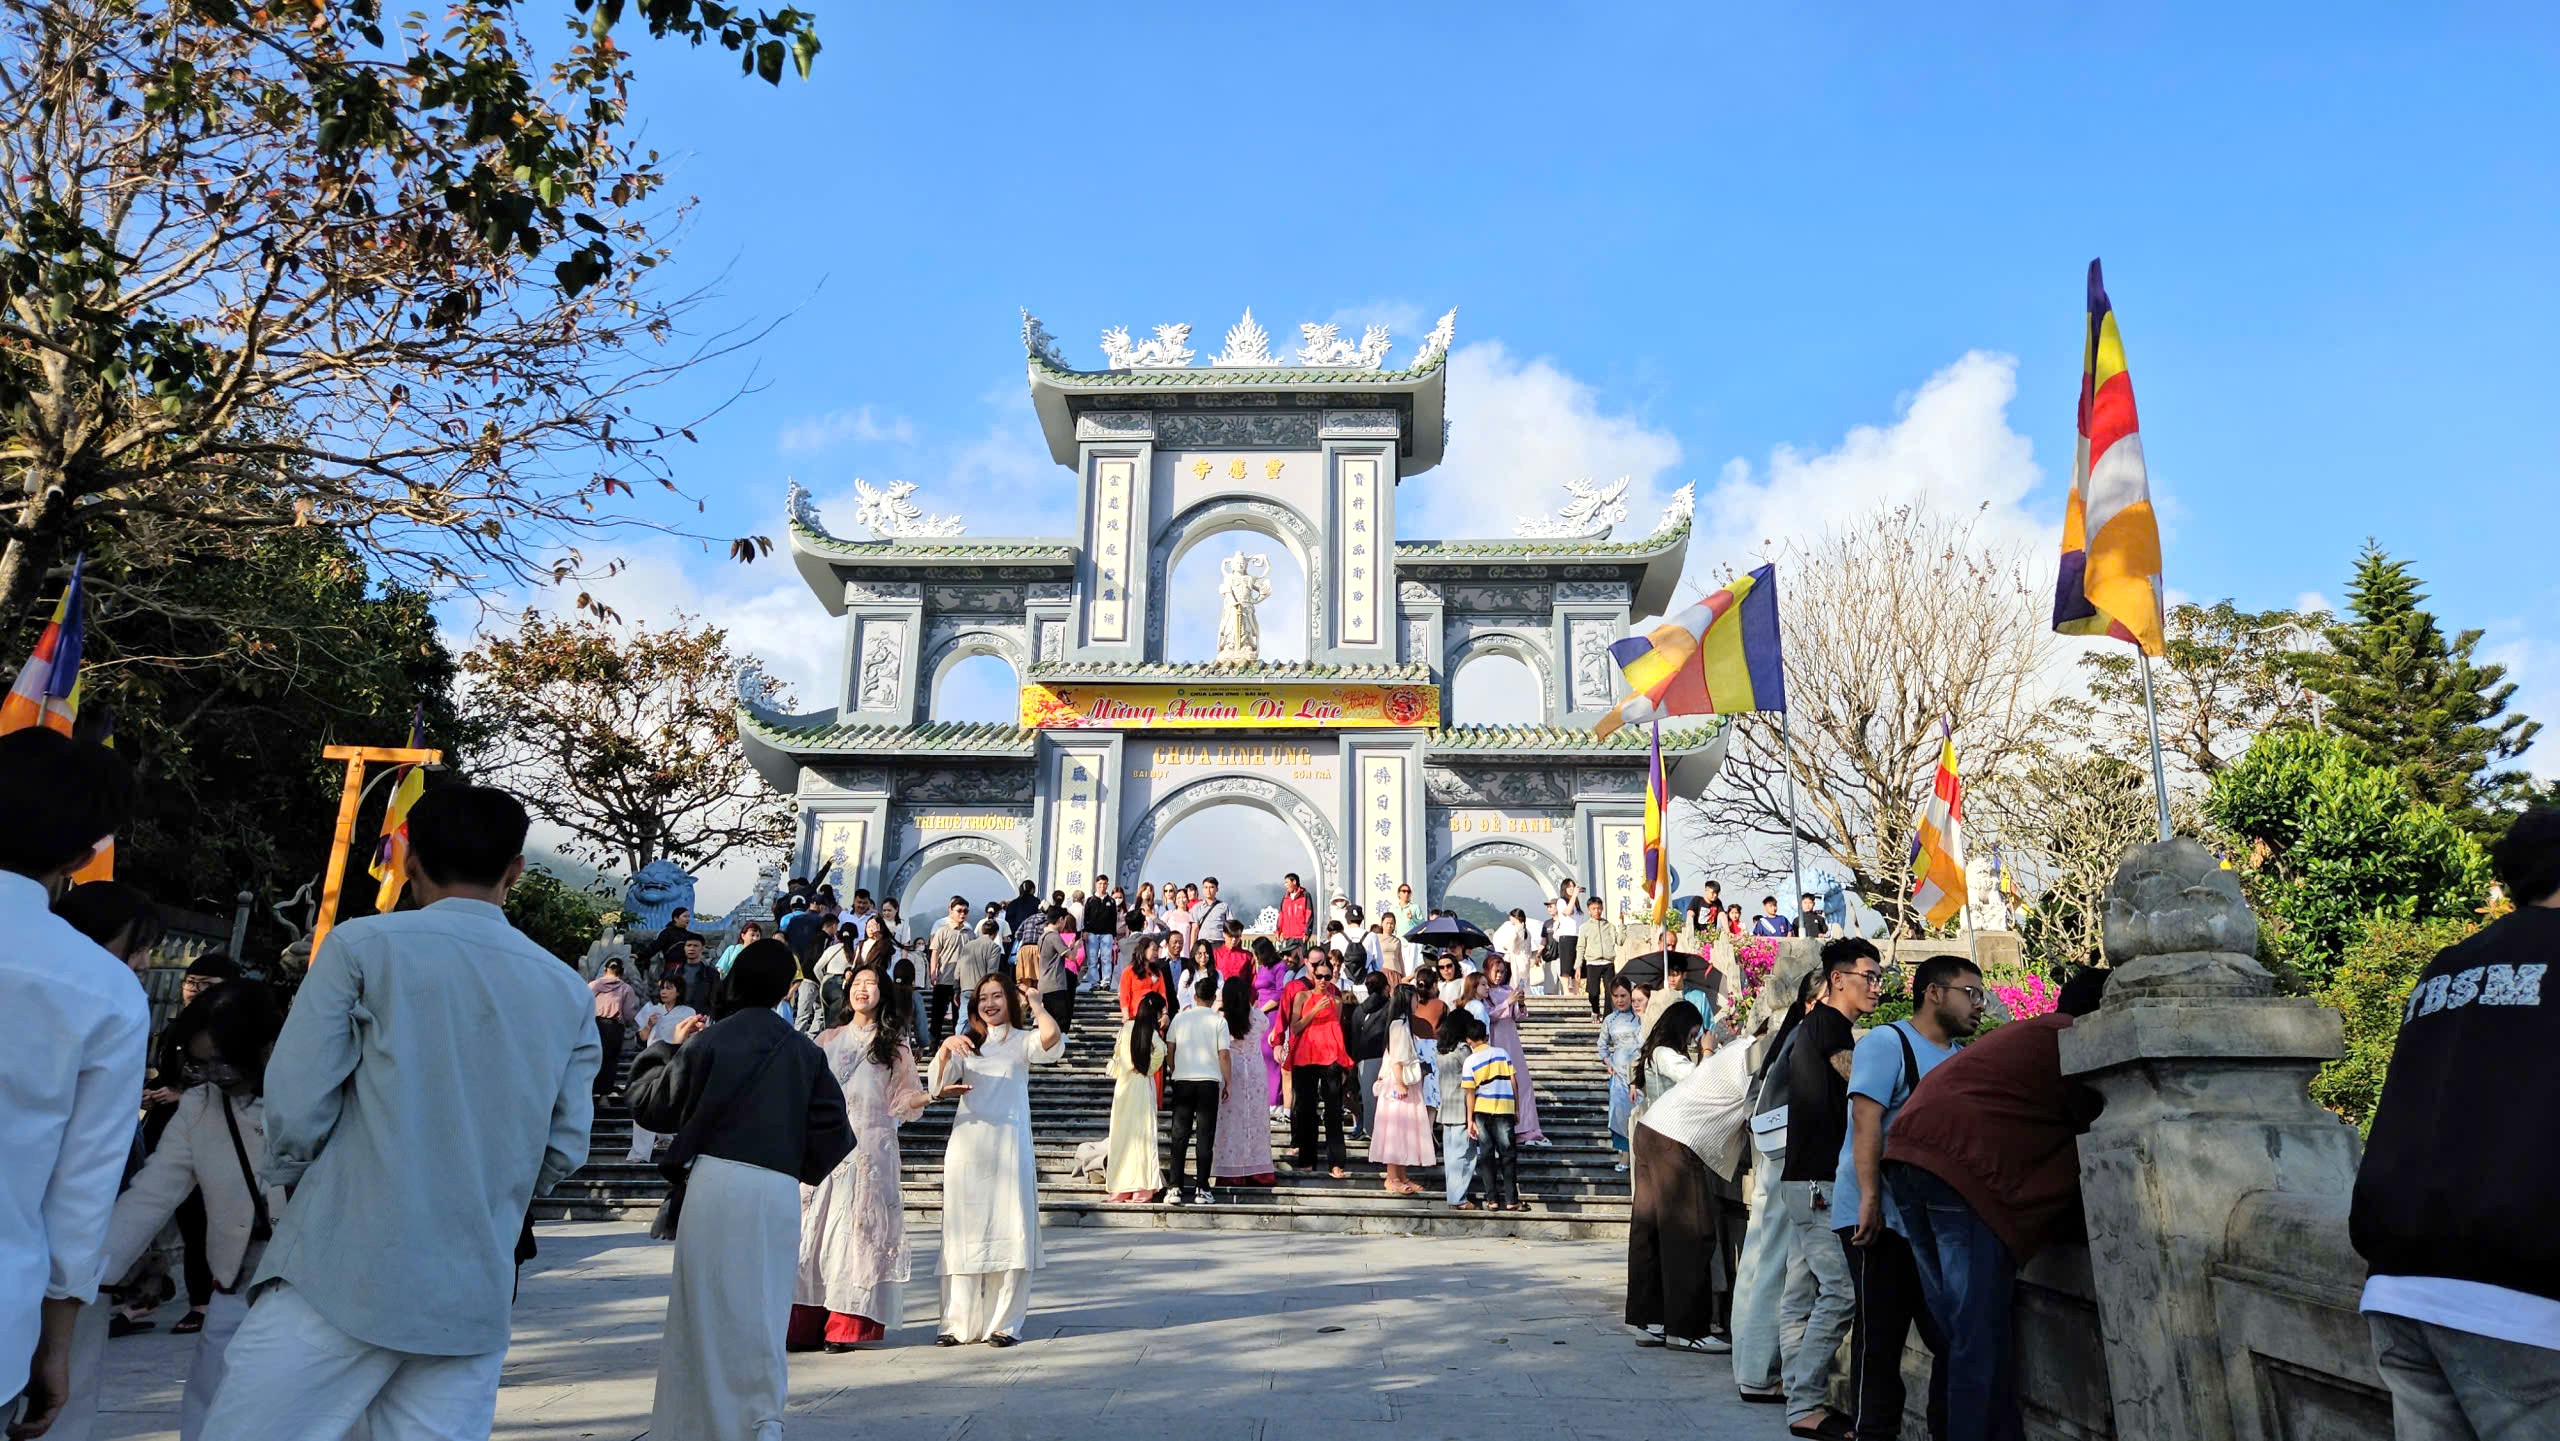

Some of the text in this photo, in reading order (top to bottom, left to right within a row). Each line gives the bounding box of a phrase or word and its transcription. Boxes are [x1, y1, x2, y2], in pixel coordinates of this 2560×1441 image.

[1085, 697, 1157, 724] Mừng
[1165, 697, 1239, 721] Xuân
[1250, 697, 1285, 720] Di
[1294, 698, 1342, 725] Lặc
[1215, 744, 1266, 765] LINH
